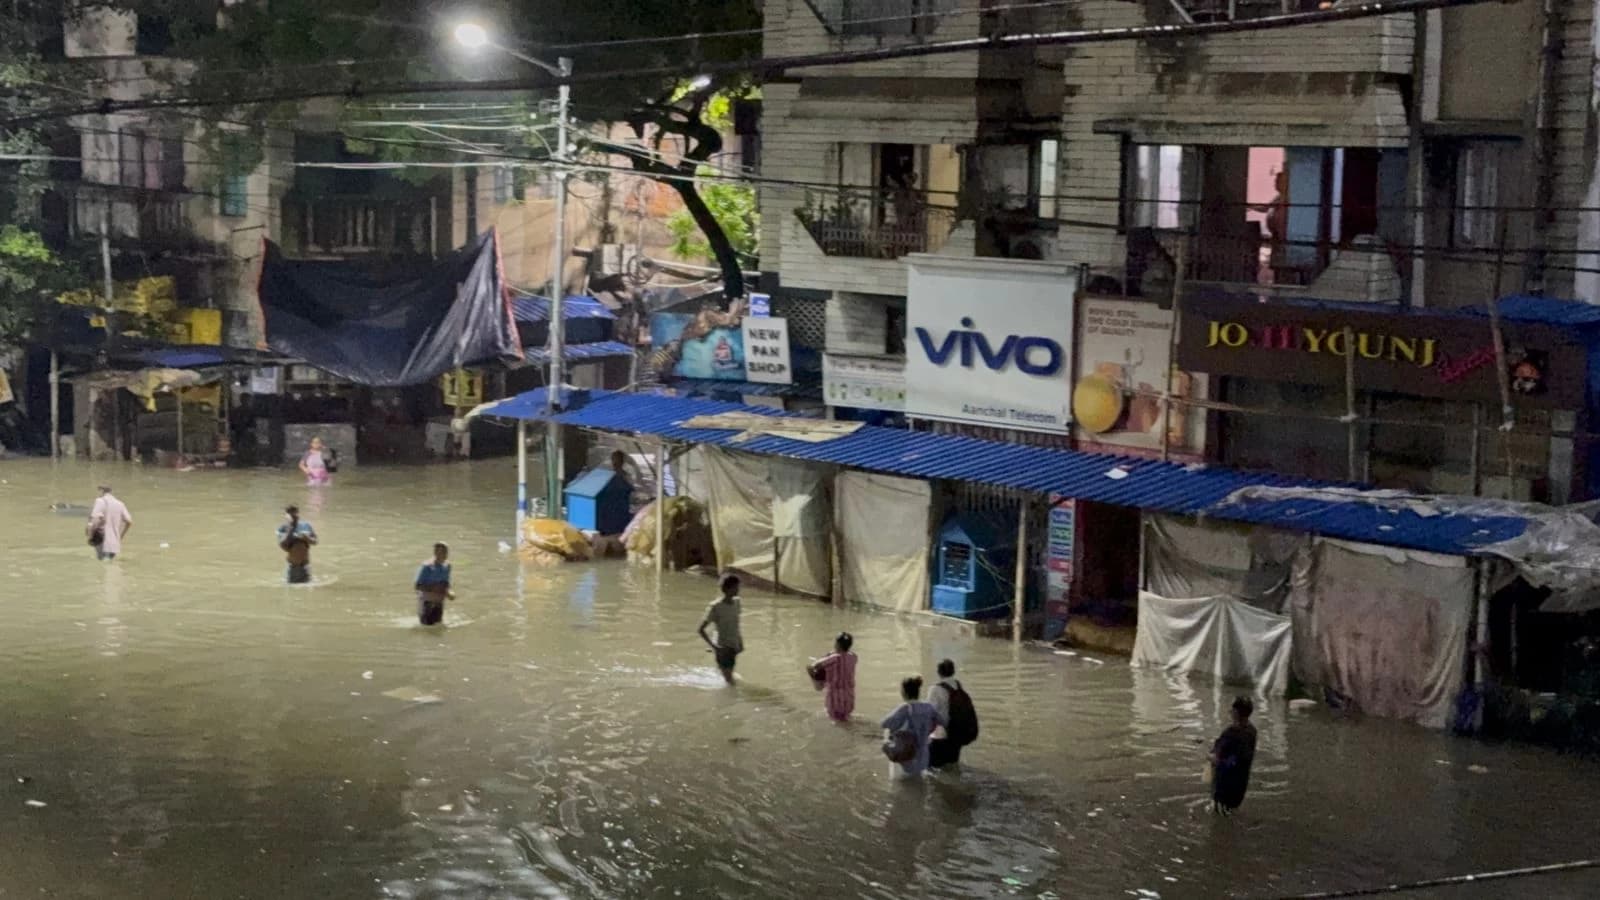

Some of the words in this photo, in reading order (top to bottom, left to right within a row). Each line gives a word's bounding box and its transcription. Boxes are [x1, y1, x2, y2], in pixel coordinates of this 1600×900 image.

[749, 328, 781, 341] NEW
[752, 345, 780, 357] PAN
[915, 316, 1063, 377] vivo
[749, 362, 786, 374] SHOP
[961, 403, 1007, 418] Aanchal
[1009, 408, 1057, 424] Telecom
